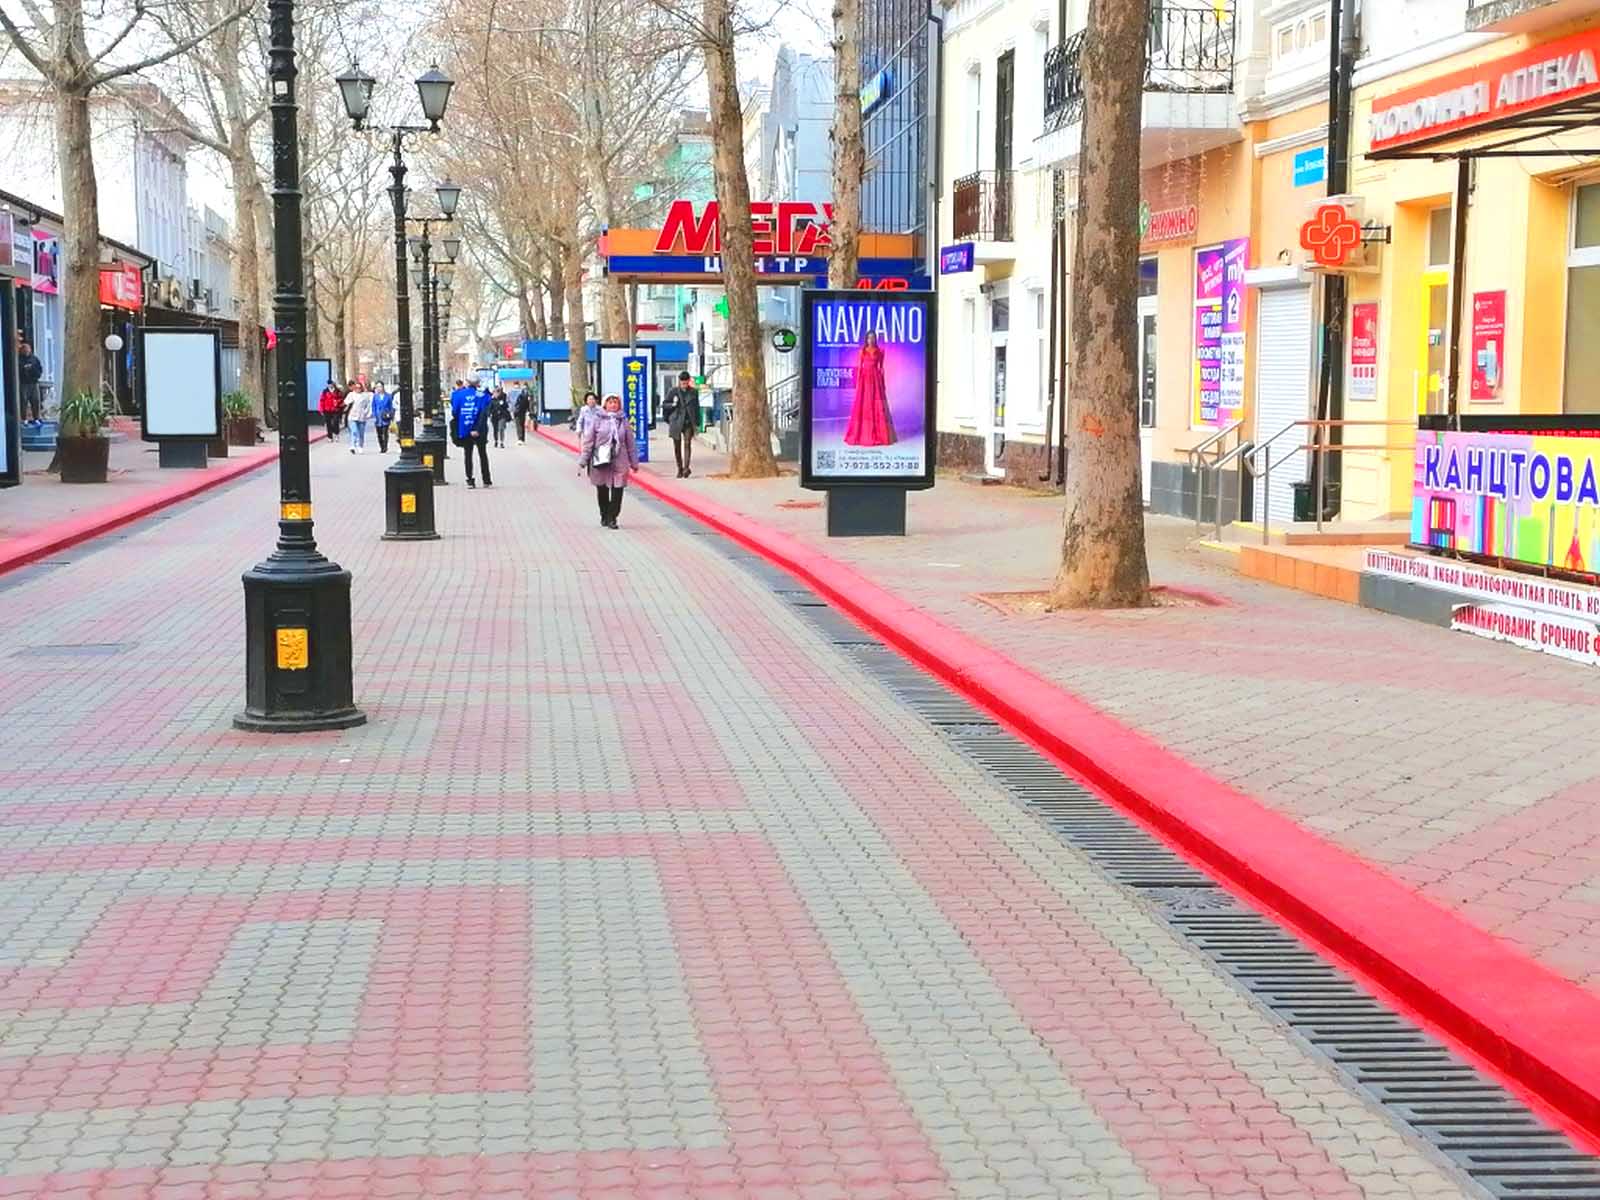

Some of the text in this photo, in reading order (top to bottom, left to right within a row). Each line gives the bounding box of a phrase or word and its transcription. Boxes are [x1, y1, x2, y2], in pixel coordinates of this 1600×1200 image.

[1496, 49, 1599, 108] АПТЕКА
[703, 256, 808, 274] ЦНТР
[817, 305, 922, 343] NAVIANO
[1424, 446, 1599, 505] КАНЦТОВА
[1462, 572, 1545, 604] ШИРОКОФОРМАТНАЯ
[1541, 622, 1590, 654] СРОЧНОЕ
